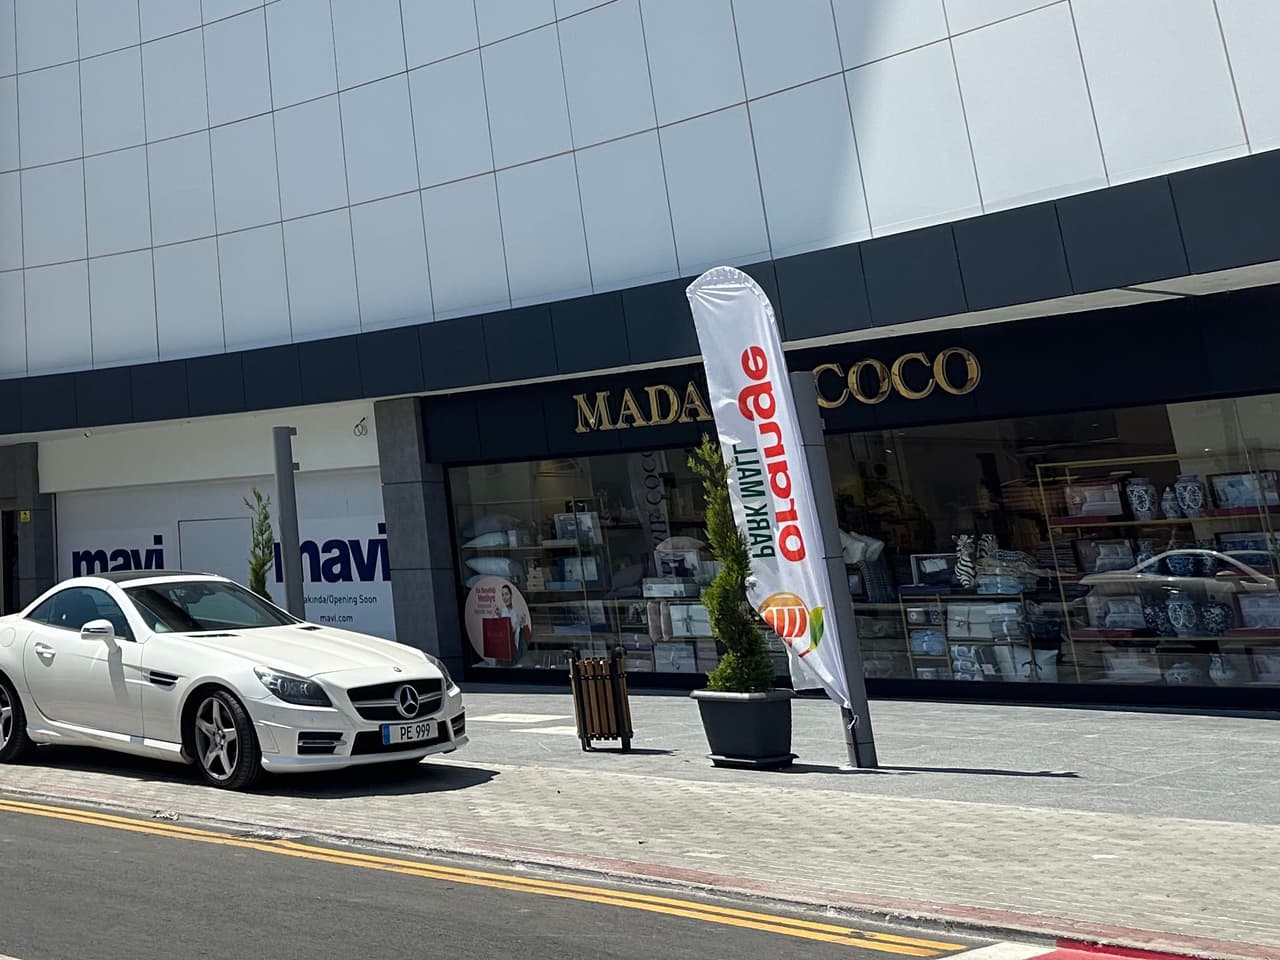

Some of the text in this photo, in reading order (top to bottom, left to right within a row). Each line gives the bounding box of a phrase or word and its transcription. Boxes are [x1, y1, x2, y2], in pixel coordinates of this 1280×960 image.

[572, 347, 981, 434] MADA COCO
[72, 534, 165, 578] mavi
[273, 522, 392, 583] mavi
[359, 594, 377, 604] Soon
[320, 615, 354, 623] mavi.com
[400, 723, 431, 741] PE 999
